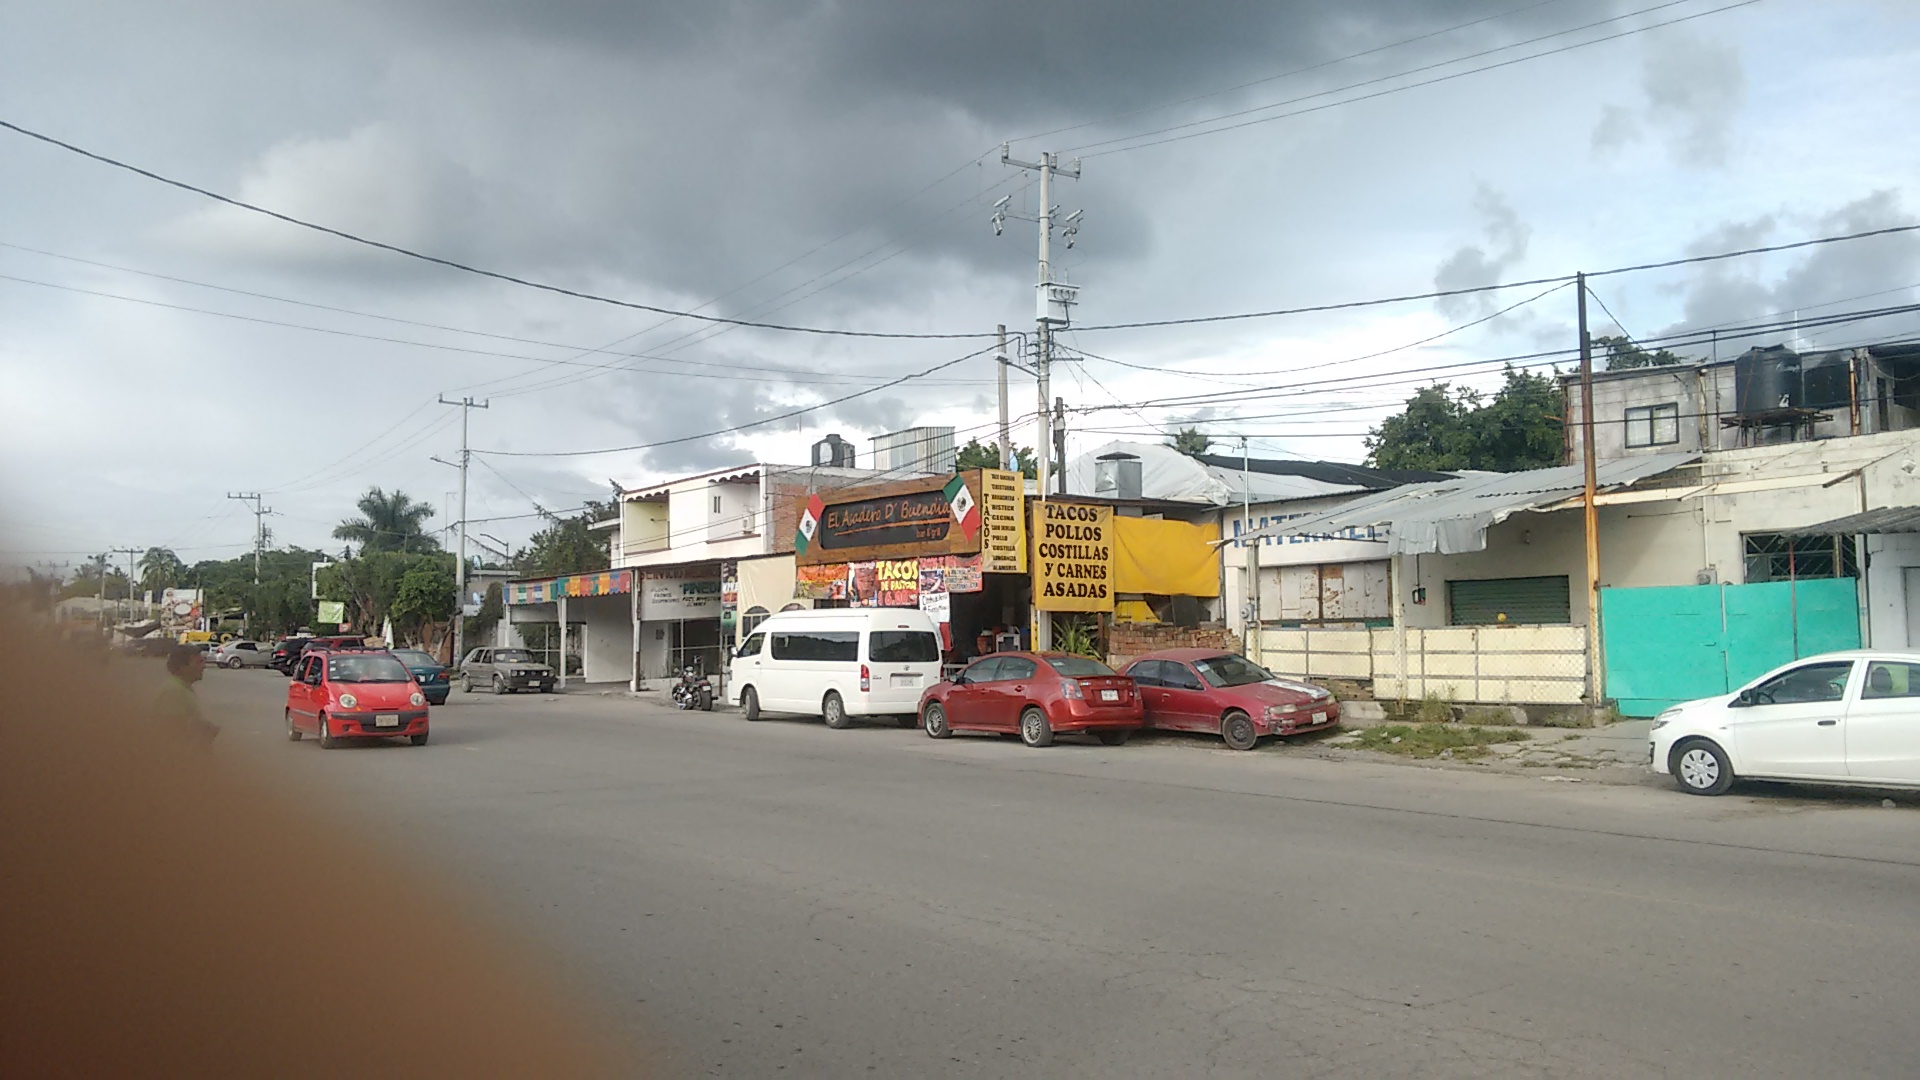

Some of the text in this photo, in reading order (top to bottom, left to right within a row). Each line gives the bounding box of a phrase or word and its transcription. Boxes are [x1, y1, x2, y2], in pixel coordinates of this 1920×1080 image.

[827, 512, 840, 529] El
[983, 493, 991, 550] TACOS
[1045, 504, 1098, 522] TACOS
[1045, 523, 1102, 541] POLLOS
[1039, 543, 1109, 561] COSTILLAS
[875, 560, 918, 580] TACOS
[1057, 563, 1107, 580] CARNES
[881, 580, 917, 591] DE PASTOR
[1043, 582, 1107, 598] ASADAS
